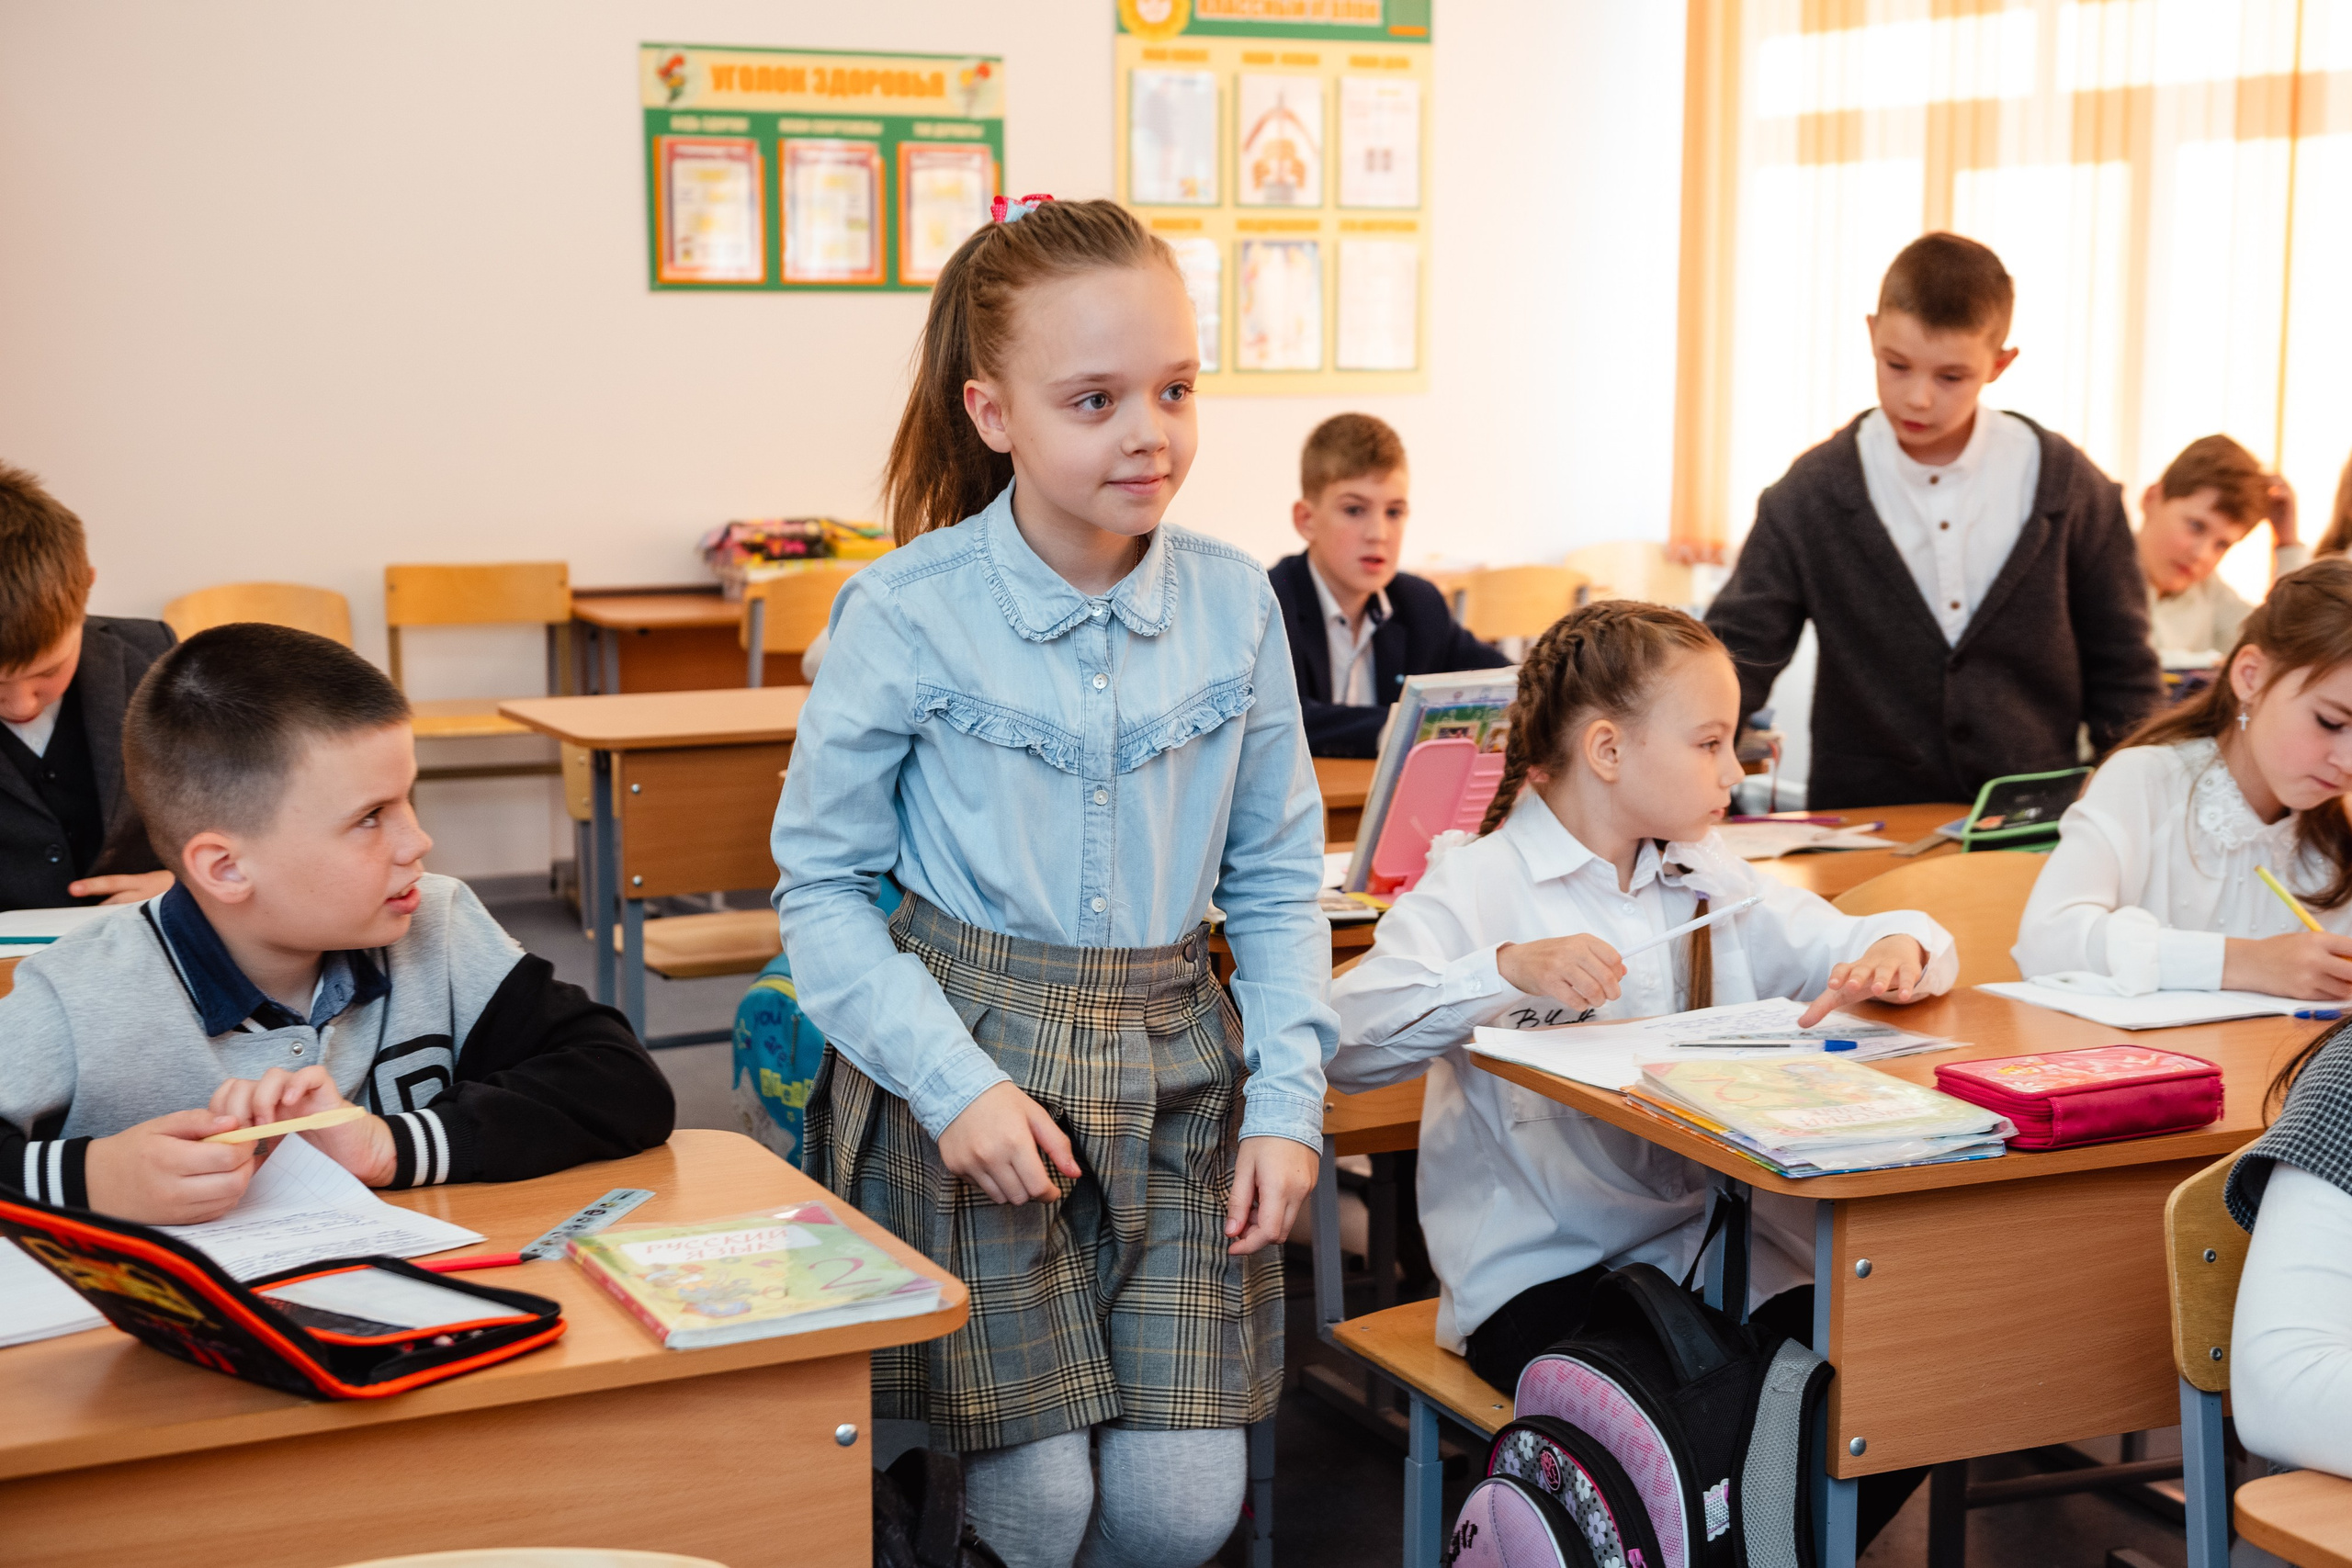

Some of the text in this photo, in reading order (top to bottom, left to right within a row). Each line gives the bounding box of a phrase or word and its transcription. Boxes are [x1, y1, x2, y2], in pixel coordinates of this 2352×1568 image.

[710, 64, 944, 98] УГОЛОК ЗДОРОВЬЯ
[646, 1226, 787, 1254] РУССКИЙ
[685, 1240, 775, 1260] ЯЗЫК
[808, 1257, 882, 1291] 2
